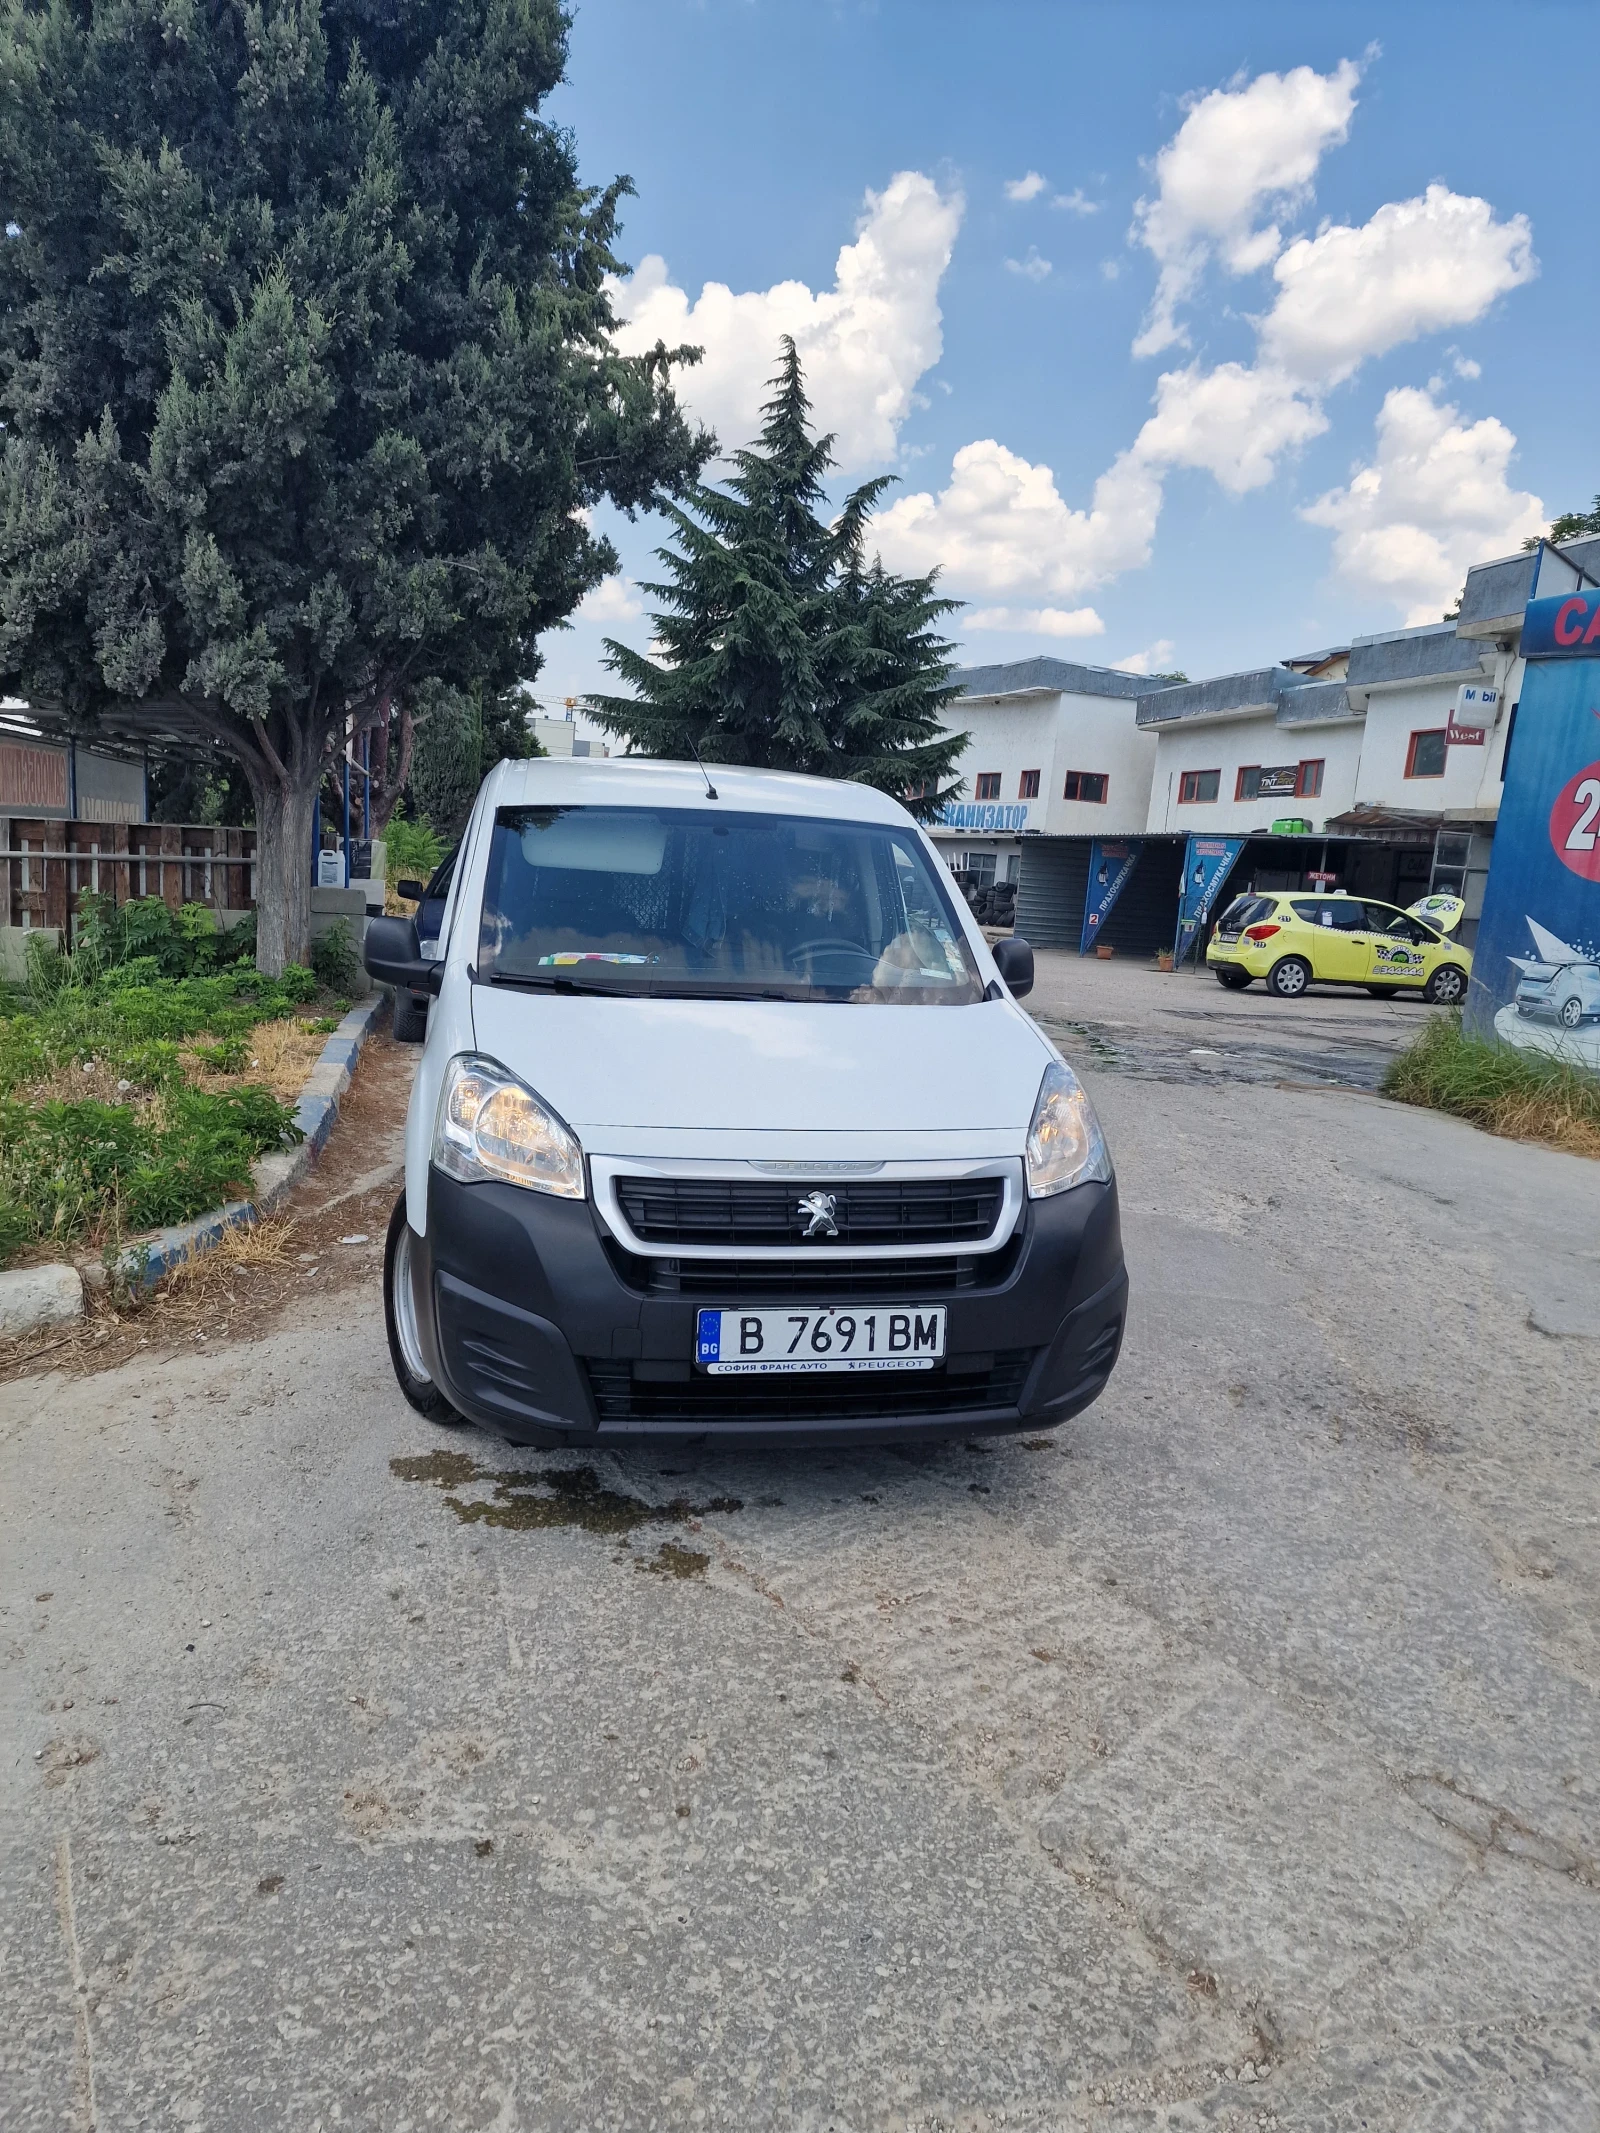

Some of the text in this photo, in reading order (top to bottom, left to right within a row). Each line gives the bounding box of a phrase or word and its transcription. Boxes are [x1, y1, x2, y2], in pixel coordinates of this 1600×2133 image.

[1449, 729, 1483, 741] West
[1277, 777, 1297, 786] PRO
[920, 804, 1028, 830] КАНИЗАТОР
[1564, 778, 1600, 851] 2
[1308, 871, 1336, 881] ЖЕТОНИ
[1099, 853, 1137, 912] ПРАХОСМУКАЧКА
[1193, 851, 1233, 919] ПРАХОСМУКАЧКА
[1091, 915, 1098, 924] 2
[774, 1162, 860, 1170] PEUGEOT
[739, 1313, 938, 1354] B 7691 BM
[701, 1343, 718, 1355] BG
[717, 1362, 828, 1372] СОФИЯ ФРАНС АУТО
[858, 1360, 925, 1369] PEUGEOT
